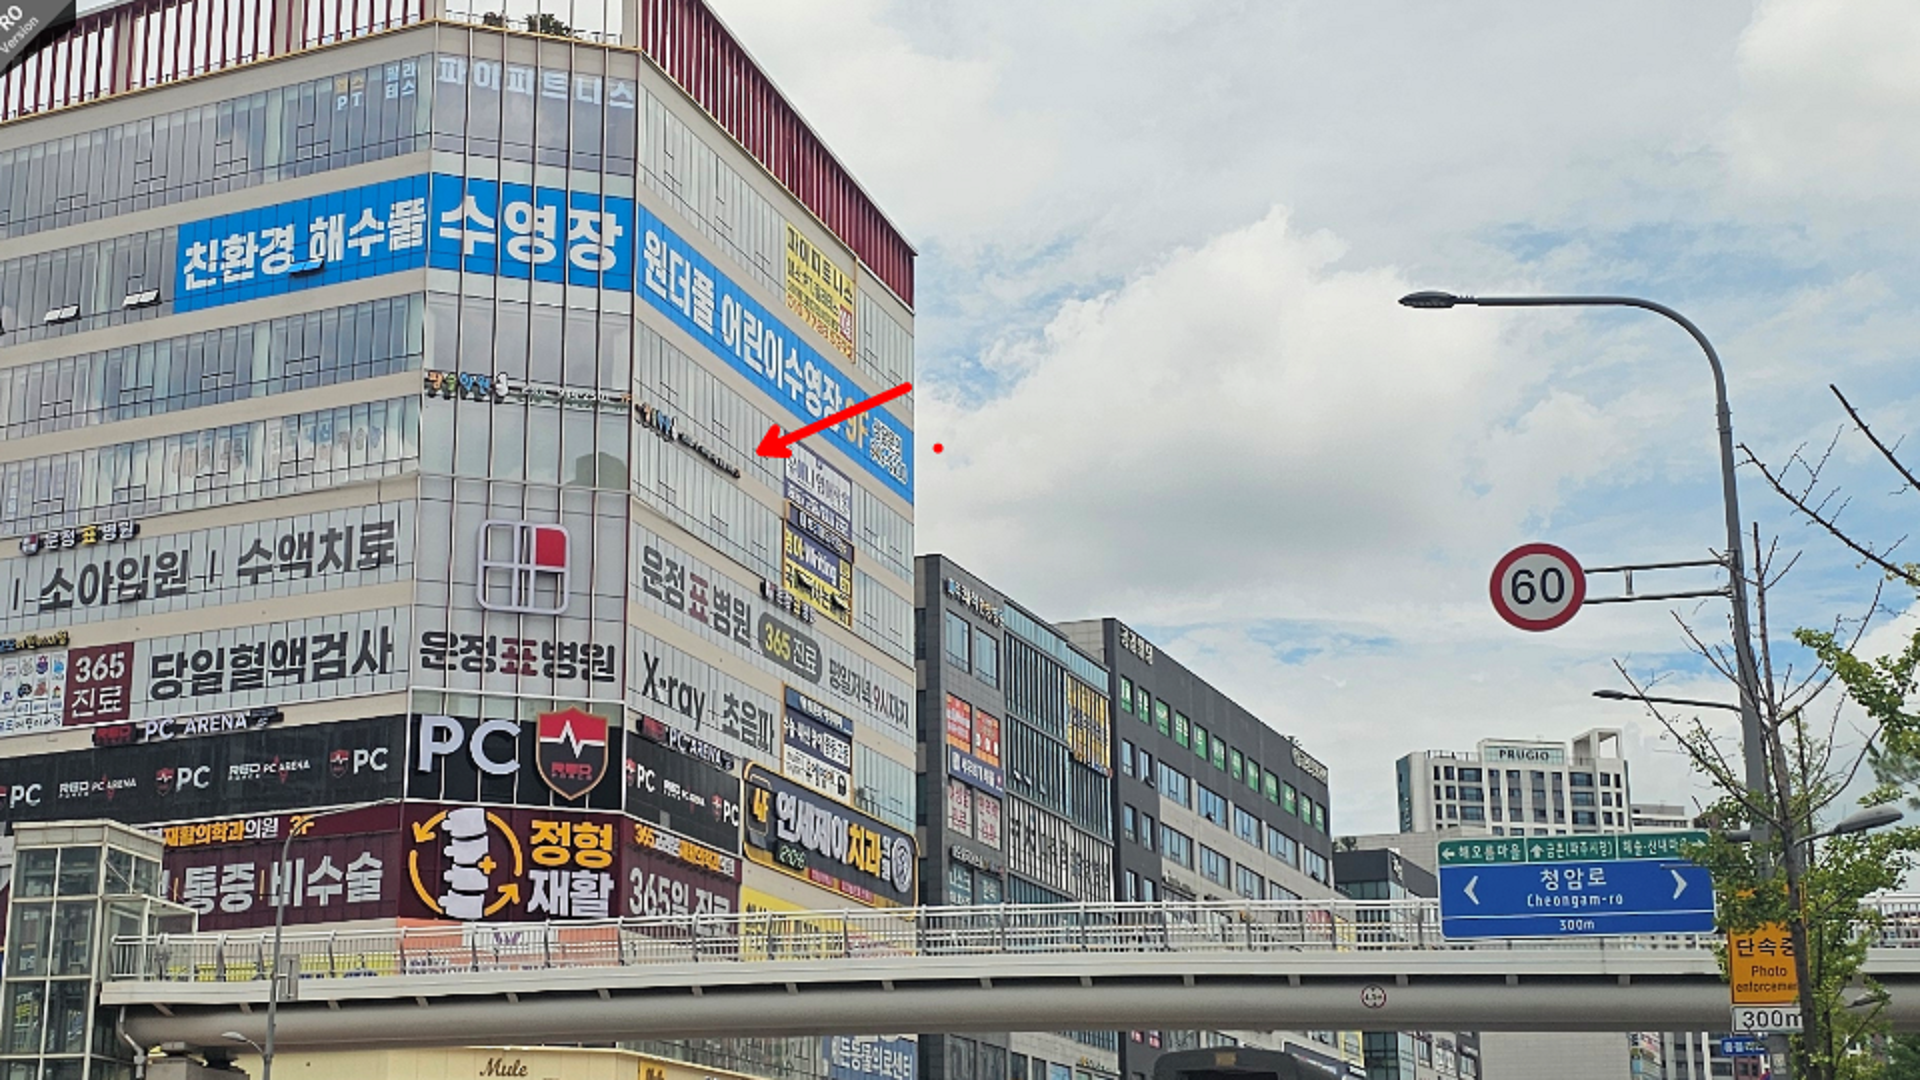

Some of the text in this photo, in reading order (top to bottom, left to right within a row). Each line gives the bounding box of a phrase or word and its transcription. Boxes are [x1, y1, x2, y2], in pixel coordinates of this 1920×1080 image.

[437, 56, 634, 110] 파이피트니스
[337, 91, 363, 111] PT
[183, 198, 427, 291] 친환경 해수풀
[439, 196, 623, 272] 수영장
[644, 229, 716, 336] 원더풀
[39, 519, 395, 612] 소아입원 수액치료
[1511, 566, 1565, 605] 60
[641, 545, 752, 648] 운정표병원
[764, 622, 791, 661] 365
[792, 637, 818, 676] 진료
[75, 652, 125, 683] 365
[150, 626, 395, 700] 당일혈액검사
[420, 631, 616, 682] 운정표병원
[71, 685, 122, 718] 진료
[643, 651, 706, 732] X-ray
[722, 691, 775, 754] 초음파
[145, 718, 176, 742] PC
[183, 712, 247, 735] ARENA
[669, 727, 688, 752] PC
[418, 714, 522, 775] PC
[1499, 749, 1550, 761] PRUGIO
[263, 763, 278, 774] PC
[278, 759, 311, 772] ARENA
[353, 747, 389, 774] PC
[91, 780, 107, 792] PC
[106, 777, 137, 791] ARENA
[176, 765, 210, 792] PC
[637, 764, 656, 793] PC
[9, 783, 42, 808] PC
[753, 787, 770, 823] 4F
[289, 816, 314, 835] 3F
[723, 798, 739, 827] PC
[529, 819, 613, 869] 정형
[184, 862, 256, 914] 통증
[271, 851, 384, 908] 비수술
[1540, 867, 1607, 891] 청암로
[527, 869, 615, 919] 재활
[630, 867, 689, 922] 365일
[1526, 893, 1624, 909] Cheongam-ro
[1559, 918, 1595, 931] 300m
[1736, 937, 1795, 958] 단속중
[1751, 965, 1788, 978] Photo
[1735, 981, 1798, 994] enforcemen
[1742, 1009, 1804, 1028] 300m
[479, 1056, 529, 1079] Mule
